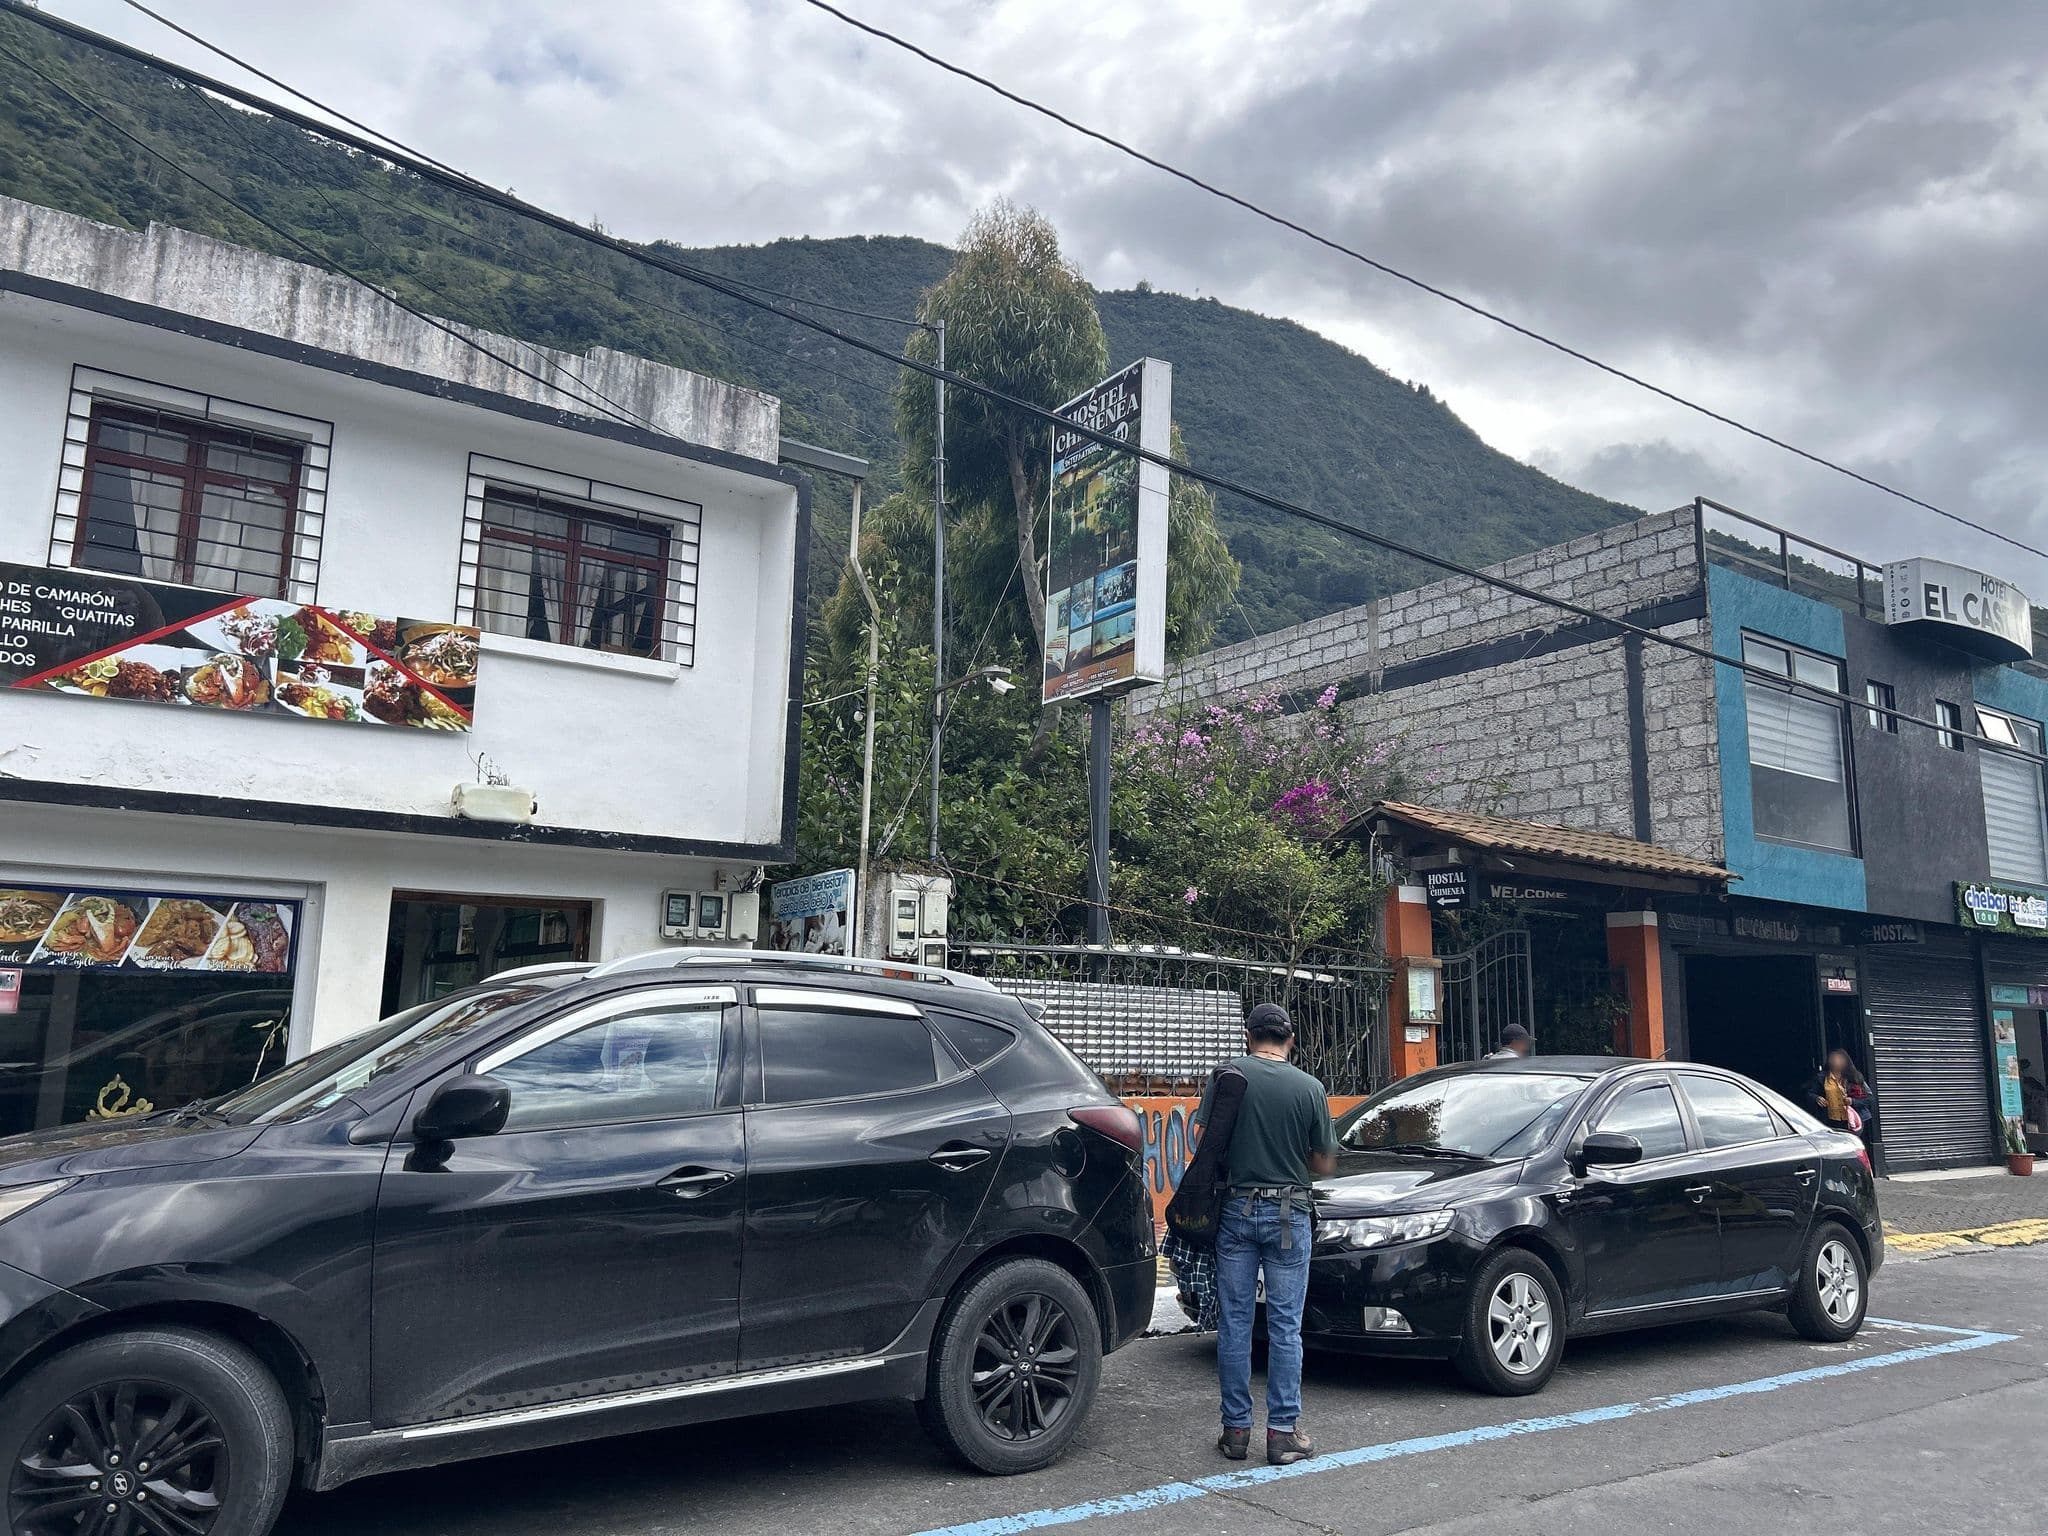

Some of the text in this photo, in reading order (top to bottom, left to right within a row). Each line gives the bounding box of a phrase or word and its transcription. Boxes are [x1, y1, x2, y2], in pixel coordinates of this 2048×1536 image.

[1056, 394, 1139, 453] CHENEA
[8, 582, 115, 608] DE CAMARÓN
[1981, 576, 2008, 601] HOTEL
[1924, 583, 1957, 622] EL
[2, 616, 75, 637] PARRILLA
[61, 606, 135, 627] GUATITAS
[0, 651, 36, 666] DOS
[800, 881, 810, 893] de
[811, 876, 843, 891] Bienestar
[1428, 872, 1467, 885] HOSTAL
[1430, 887, 1465, 897] CHIMENEA
[1490, 884, 1568, 899] WELCOME
[1965, 885, 2007, 911] chebas
[1873, 924, 1916, 942] HOSTAL
